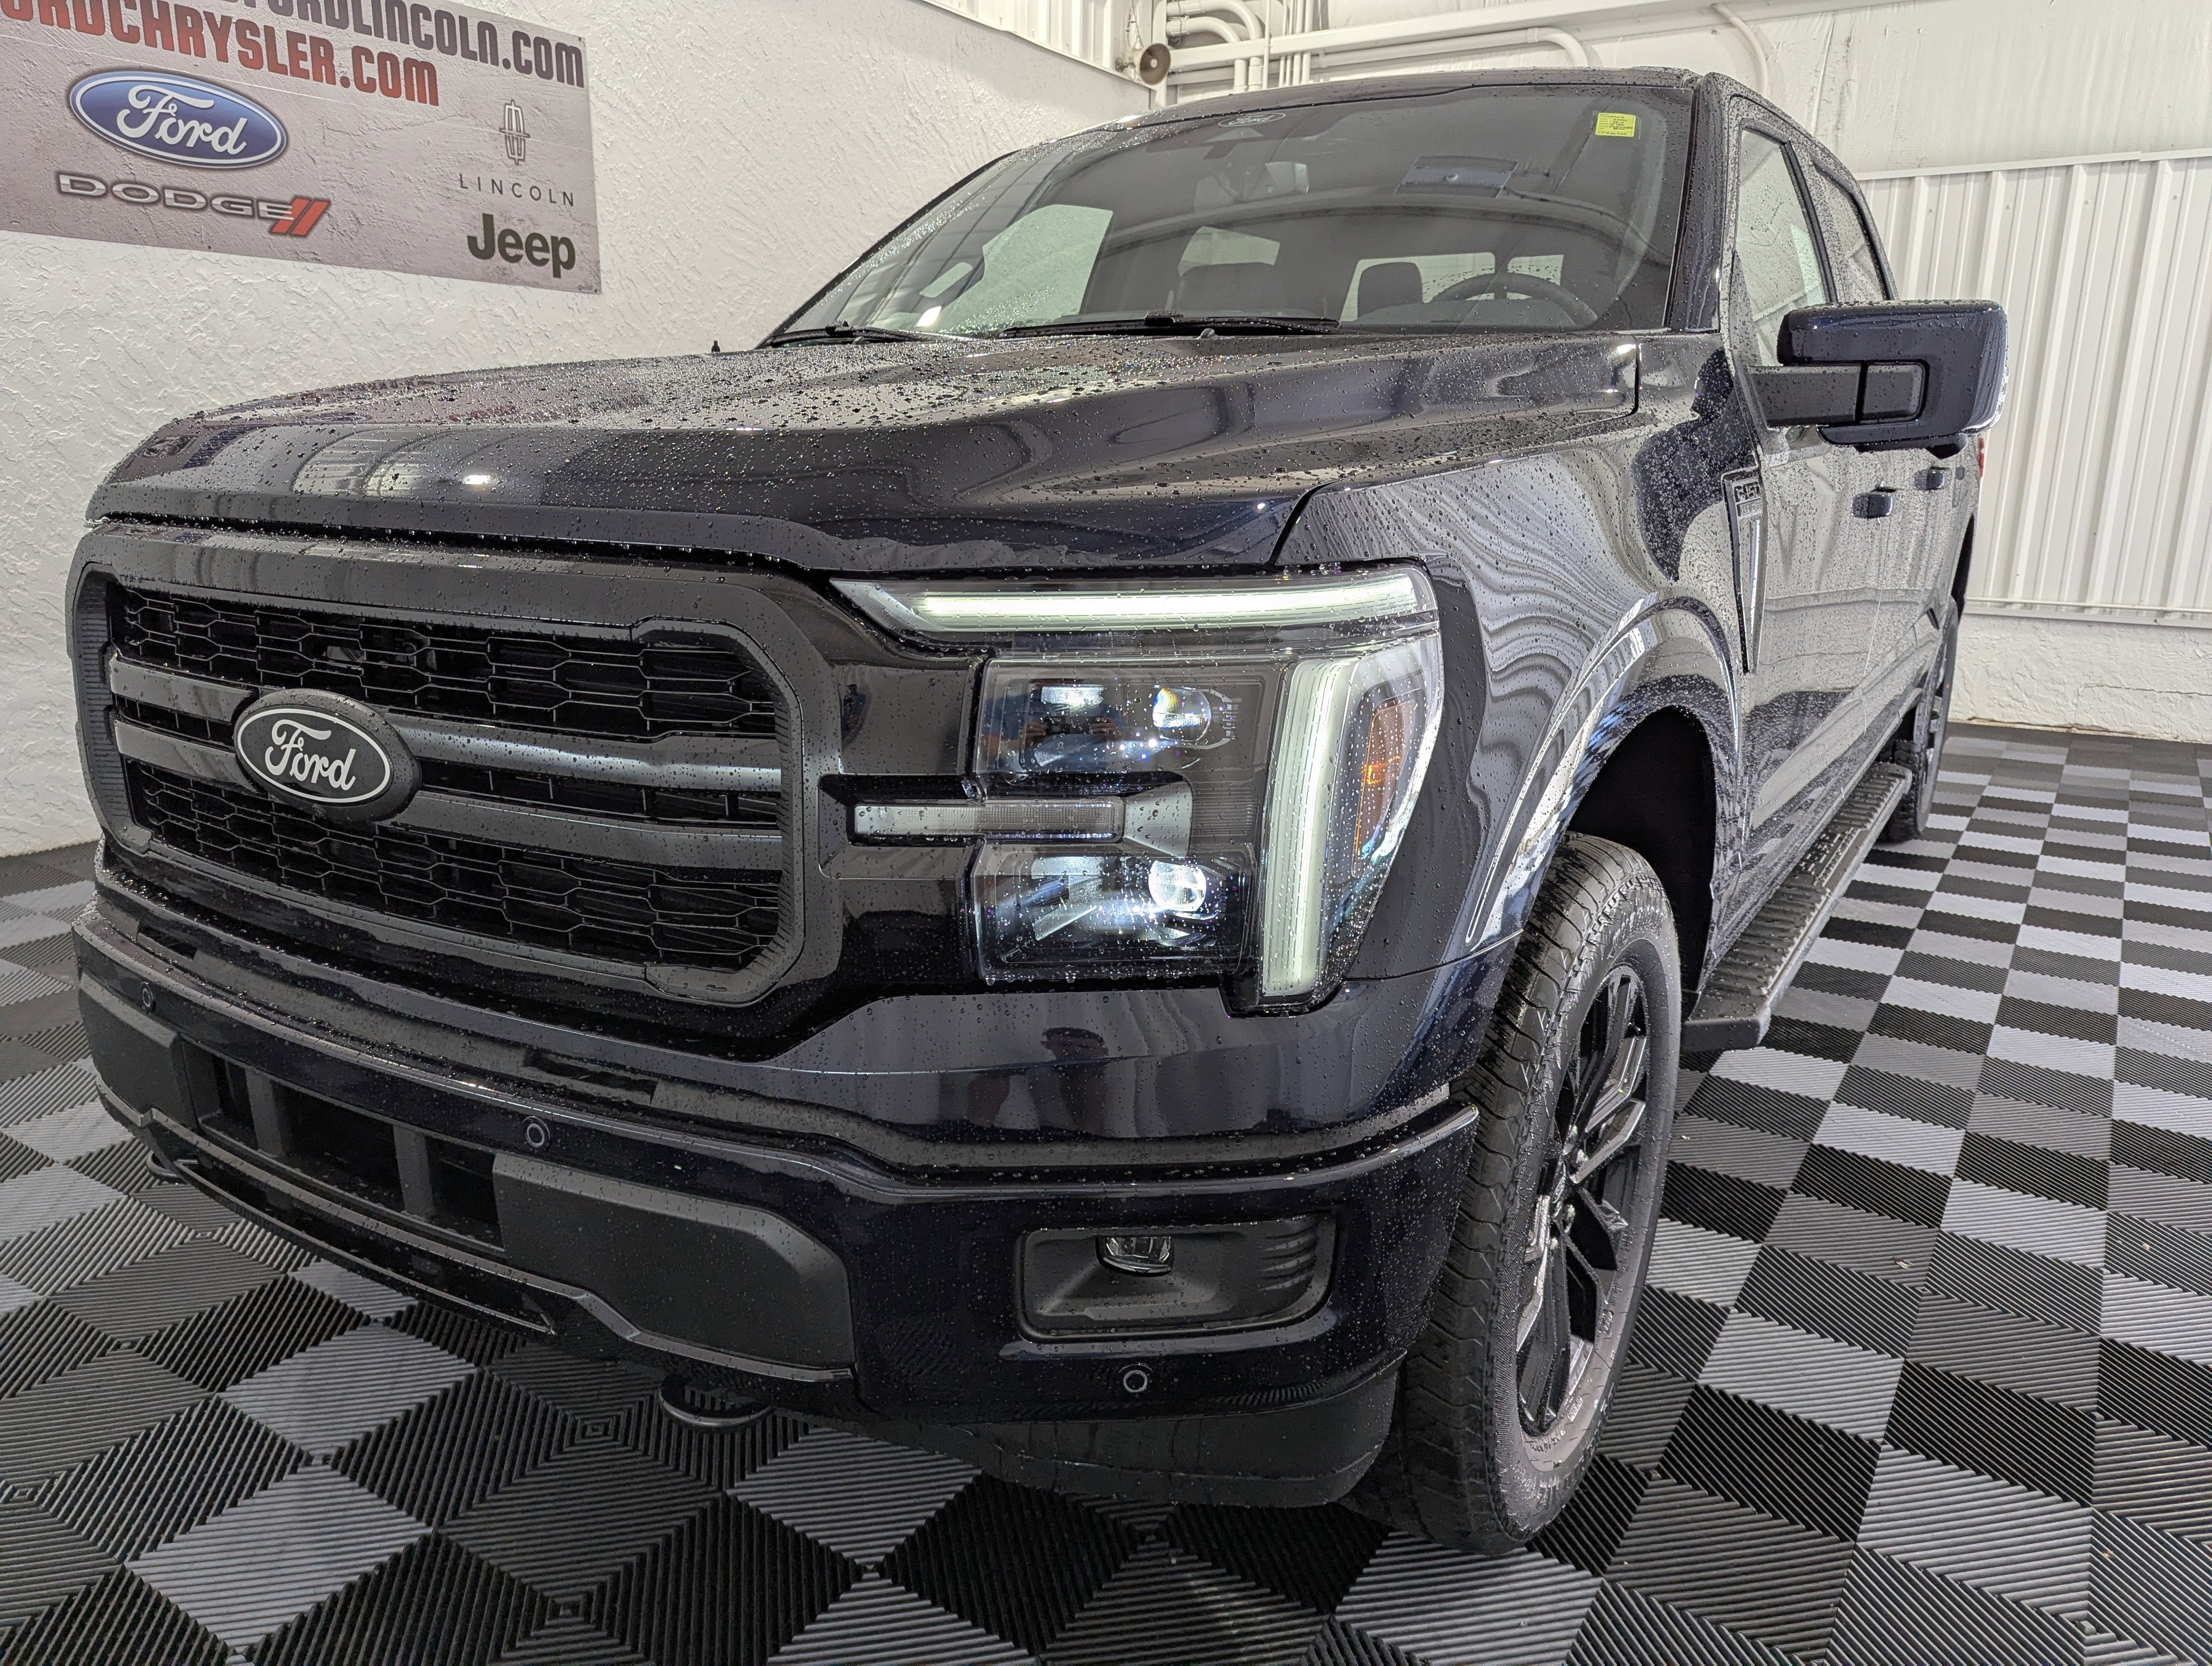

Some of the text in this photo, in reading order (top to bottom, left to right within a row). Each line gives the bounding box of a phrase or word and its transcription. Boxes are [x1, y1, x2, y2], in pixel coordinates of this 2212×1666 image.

[224, 0, 584, 88] DLINCOLN.COM
[117, 85, 247, 155] Ford
[59, 174, 294, 221] DODGE
[460, 173, 574, 207] LINCOLN
[467, 213, 576, 279] Jeep
[265, 719, 356, 791] Ford
